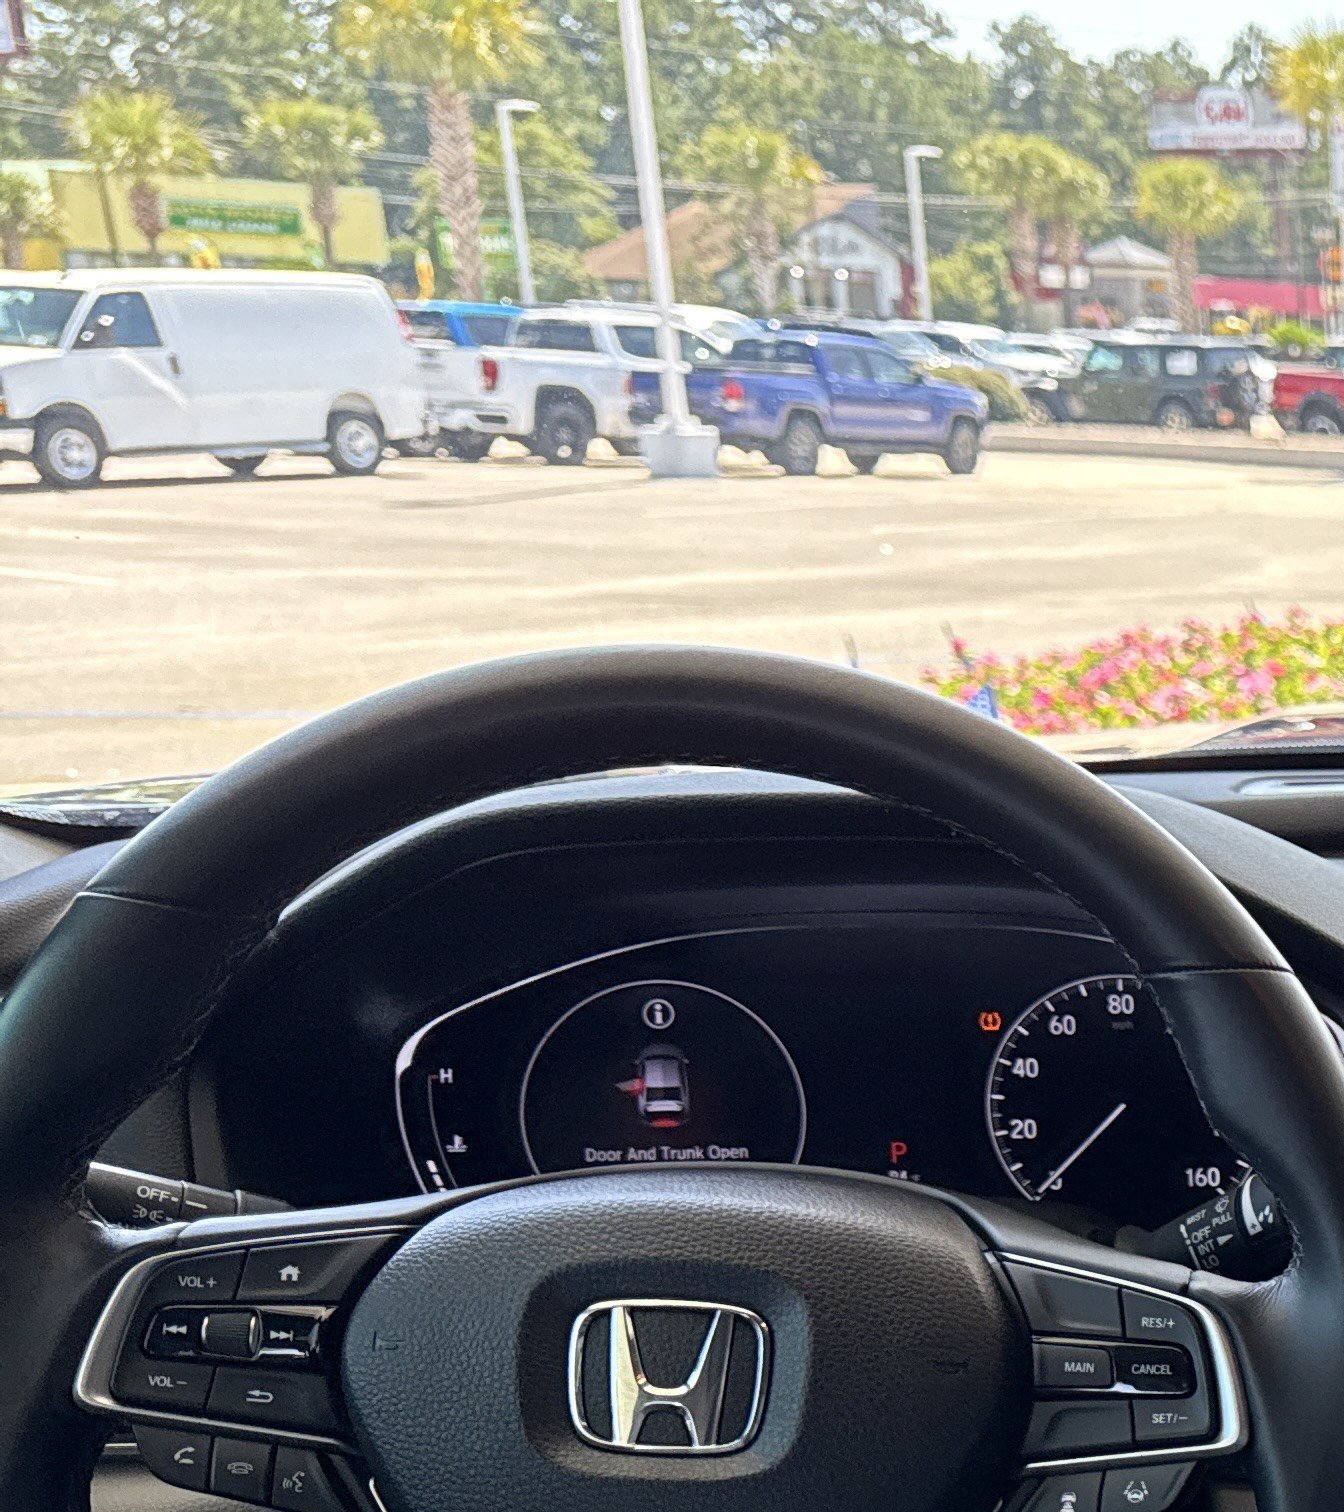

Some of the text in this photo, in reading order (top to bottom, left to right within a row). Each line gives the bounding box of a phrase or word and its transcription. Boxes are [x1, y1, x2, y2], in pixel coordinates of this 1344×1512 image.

[1107, 994, 1135, 1015] 80
[1049, 1014, 1077, 1036] 60
[439, 1067, 454, 1084] H
[1011, 1057, 1040, 1079] 40
[1009, 1118, 1038, 1139] 20
[584, 1144, 750, 1163] Door And Trunk Open
[890, 1141, 908, 1164] P
[1185, 1166, 1221, 1188] 160
[136, 1185, 172, 1203] OFF
[1212, 1211, 1236, 1227] PULL
[1191, 1225, 1212, 1244] OFF
[1197, 1239, 1216, 1256] INT
[1064, 1361, 1096, 1374] MAIN
[1131, 1363, 1173, 1376] CANCEL
